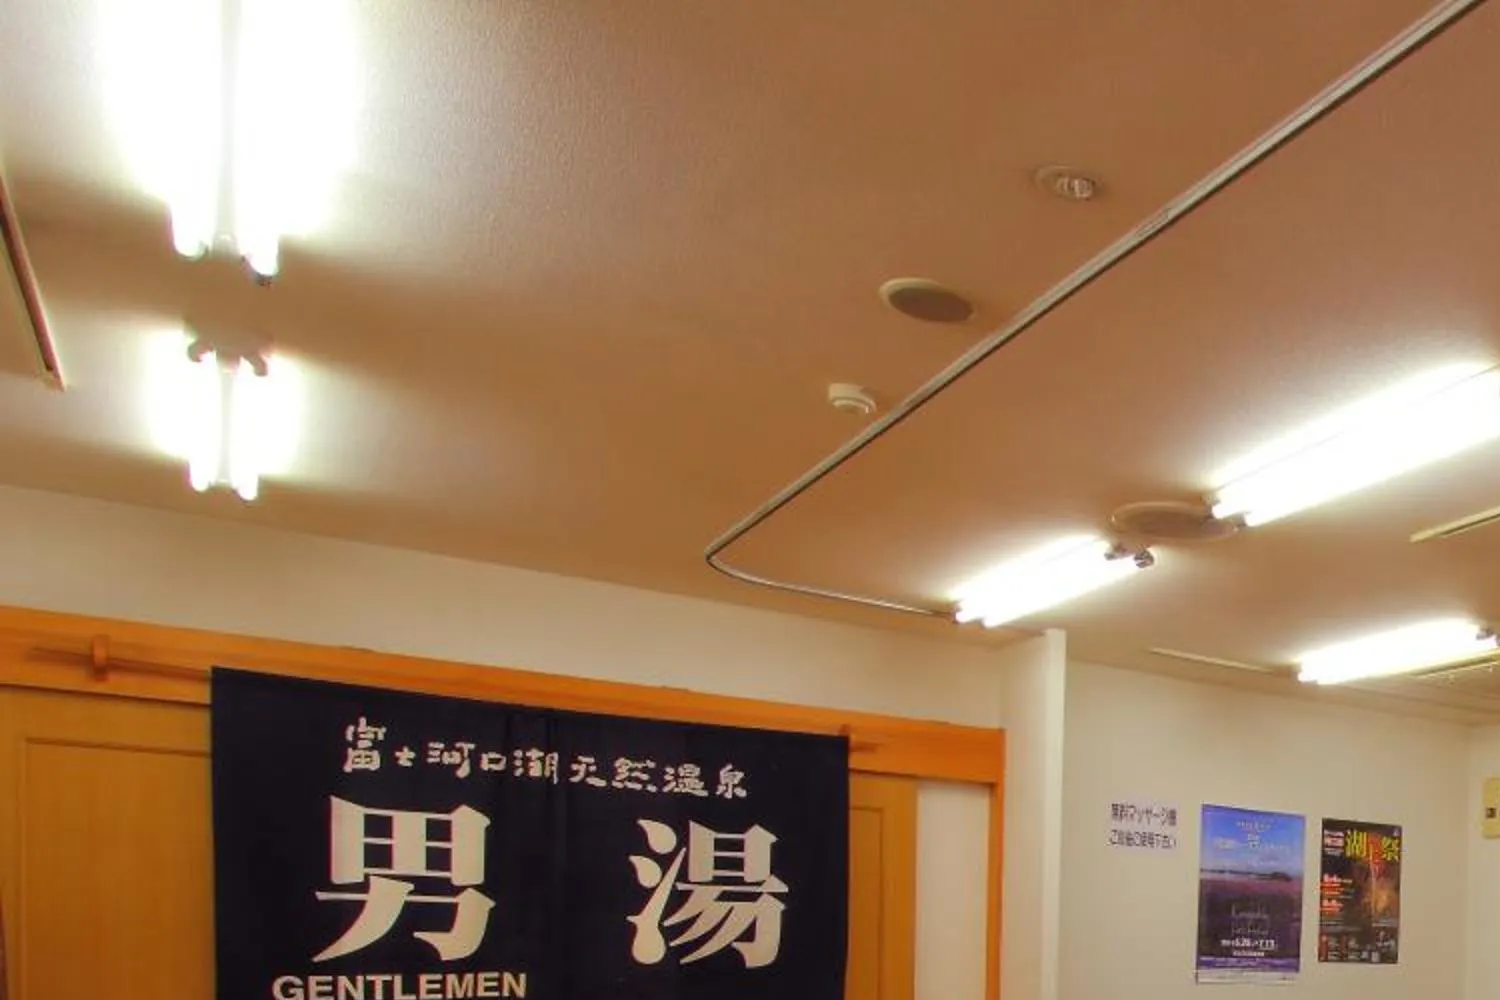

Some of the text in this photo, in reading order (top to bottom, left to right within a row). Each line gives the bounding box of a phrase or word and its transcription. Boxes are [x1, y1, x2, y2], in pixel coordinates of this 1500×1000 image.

[344, 717, 748, 799] 富士河口湖天然温泉
